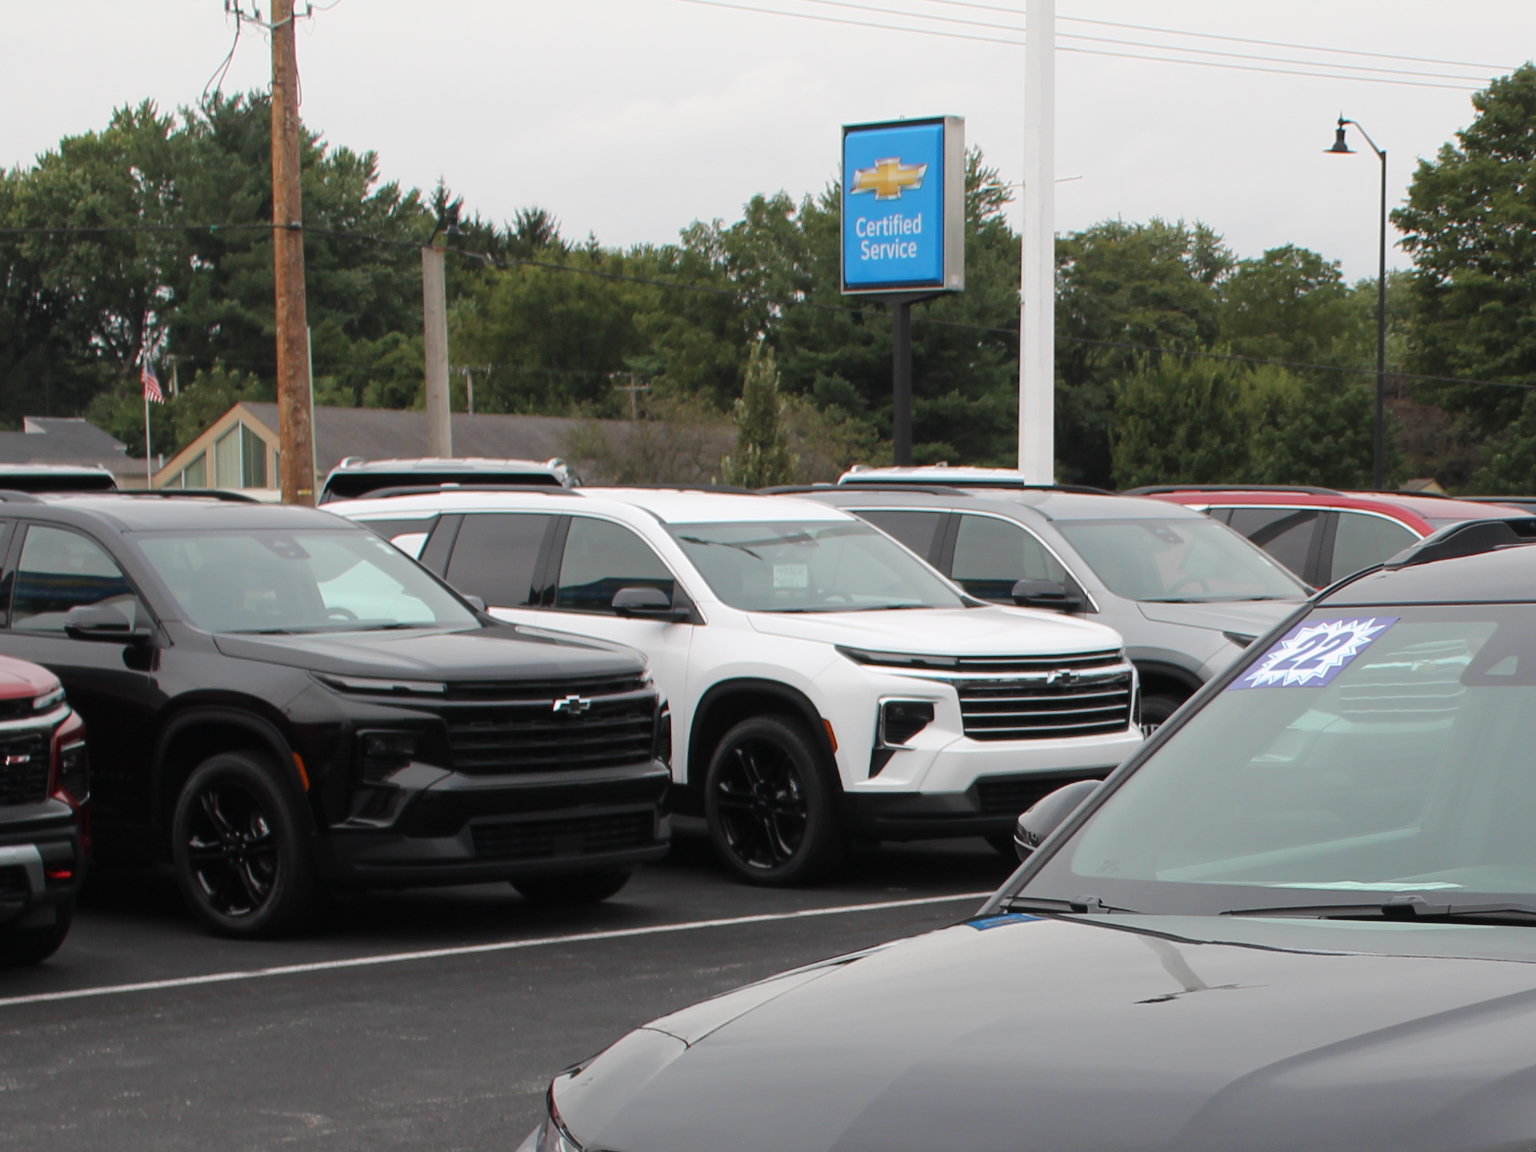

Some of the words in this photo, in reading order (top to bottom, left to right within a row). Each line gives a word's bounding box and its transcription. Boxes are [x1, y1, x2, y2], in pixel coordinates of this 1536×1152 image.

[855, 213, 922, 237] Certified
[860, 239, 917, 260] Service
[1267, 631, 1356, 671] 22
